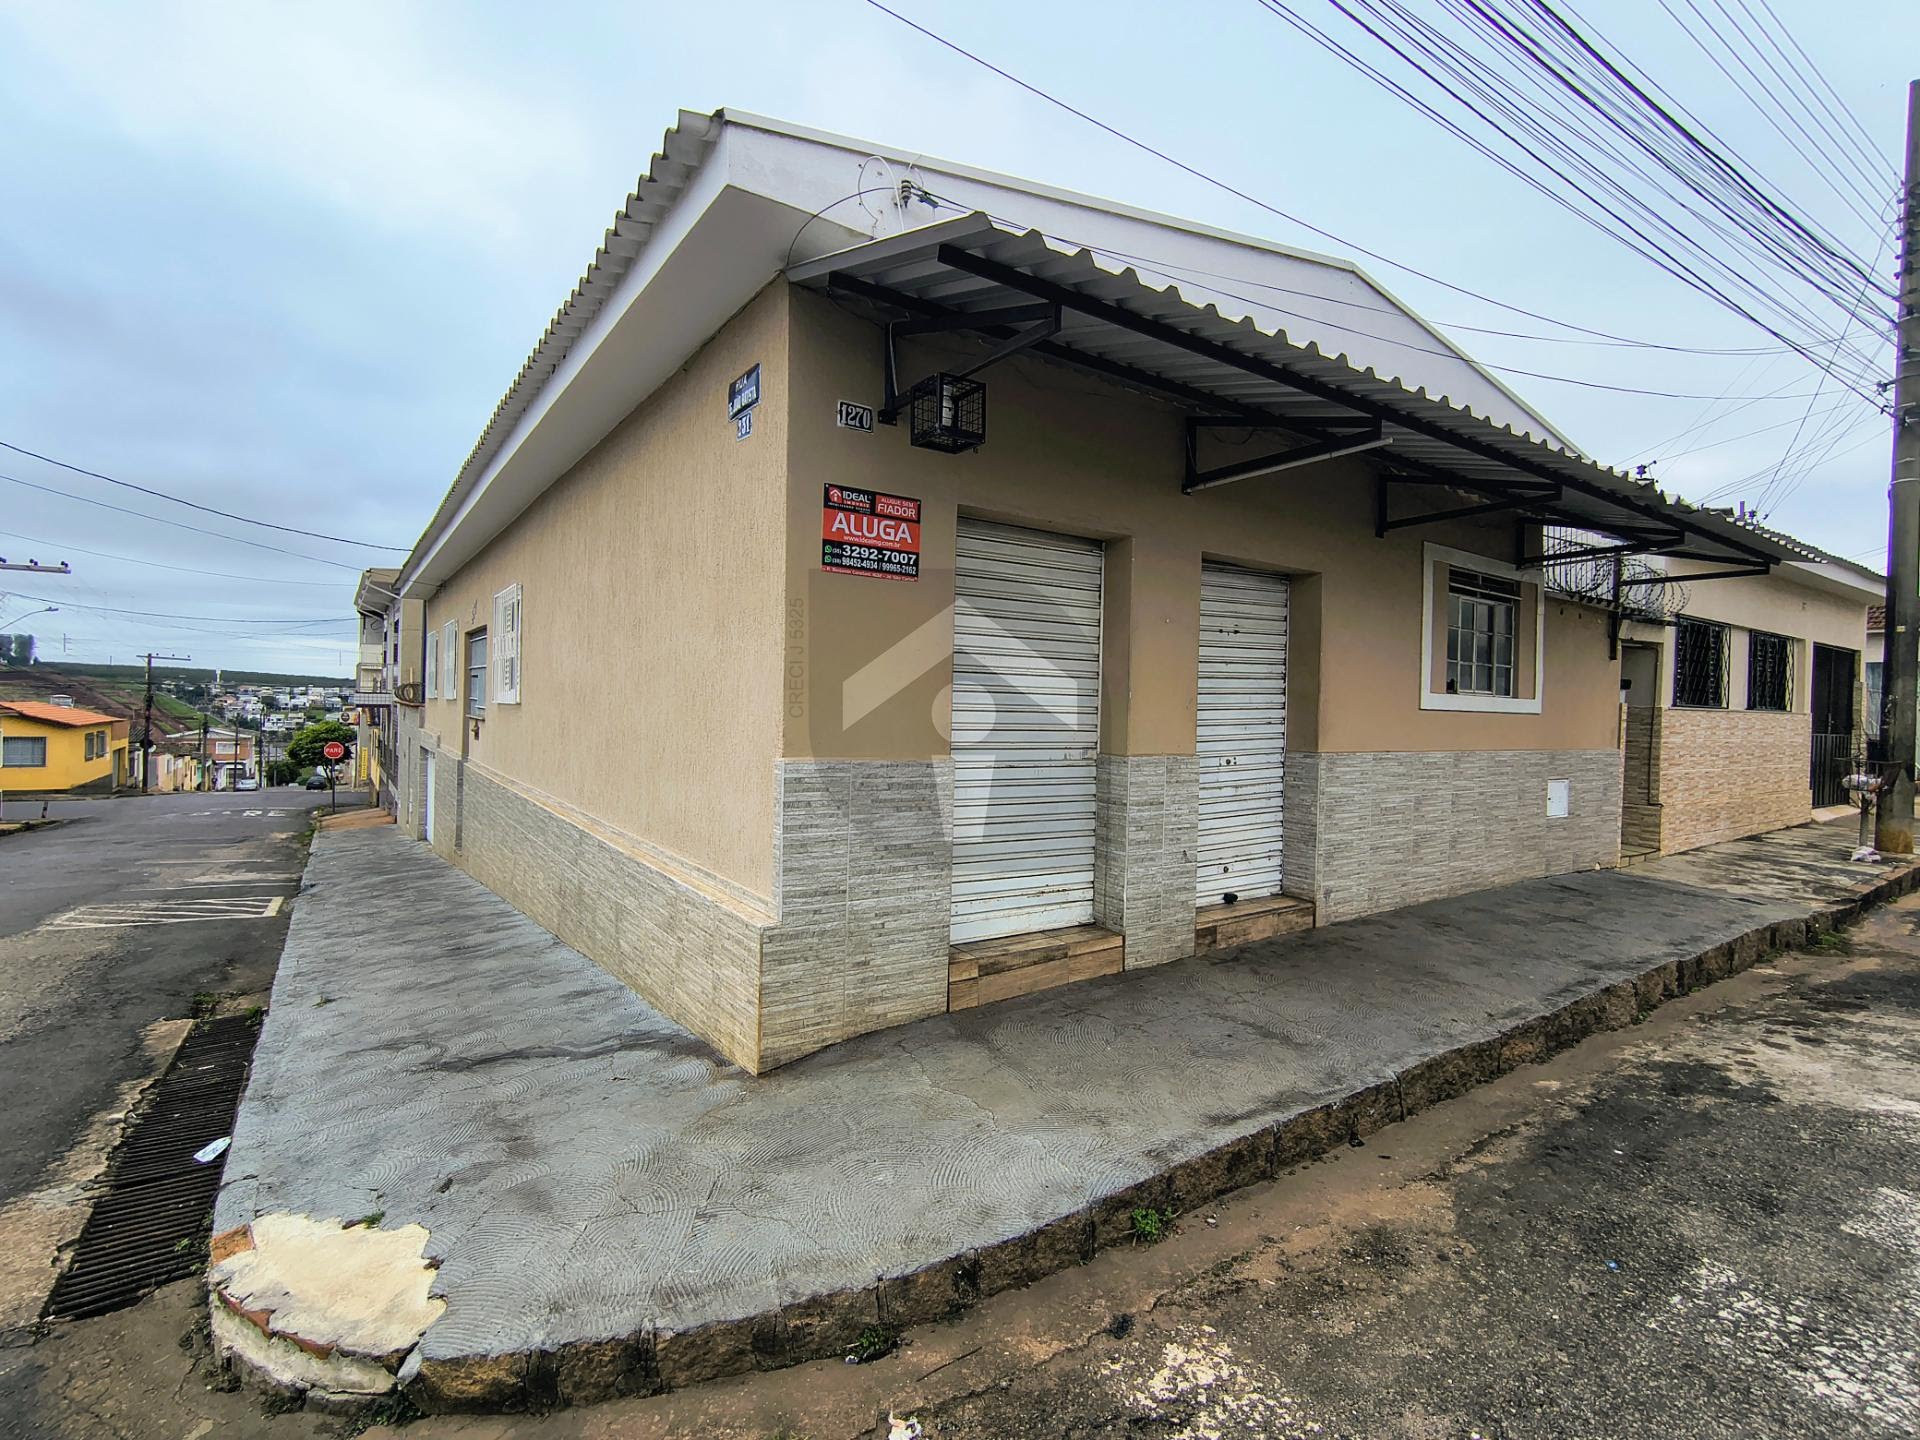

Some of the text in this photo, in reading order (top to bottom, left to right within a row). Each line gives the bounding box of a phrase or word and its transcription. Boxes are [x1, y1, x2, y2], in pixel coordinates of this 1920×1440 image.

[735, 374, 748, 393] RUA
[840, 404, 870, 429] 1270
[842, 490, 871, 503] IDEAL
[881, 497, 900, 506] ALUGUE
[877, 504, 916, 518] FIADOR
[831, 512, 913, 544] ALUGA
[842, 544, 917, 565] 3292-7007
[842, 557, 878, 569] 98452-4934
